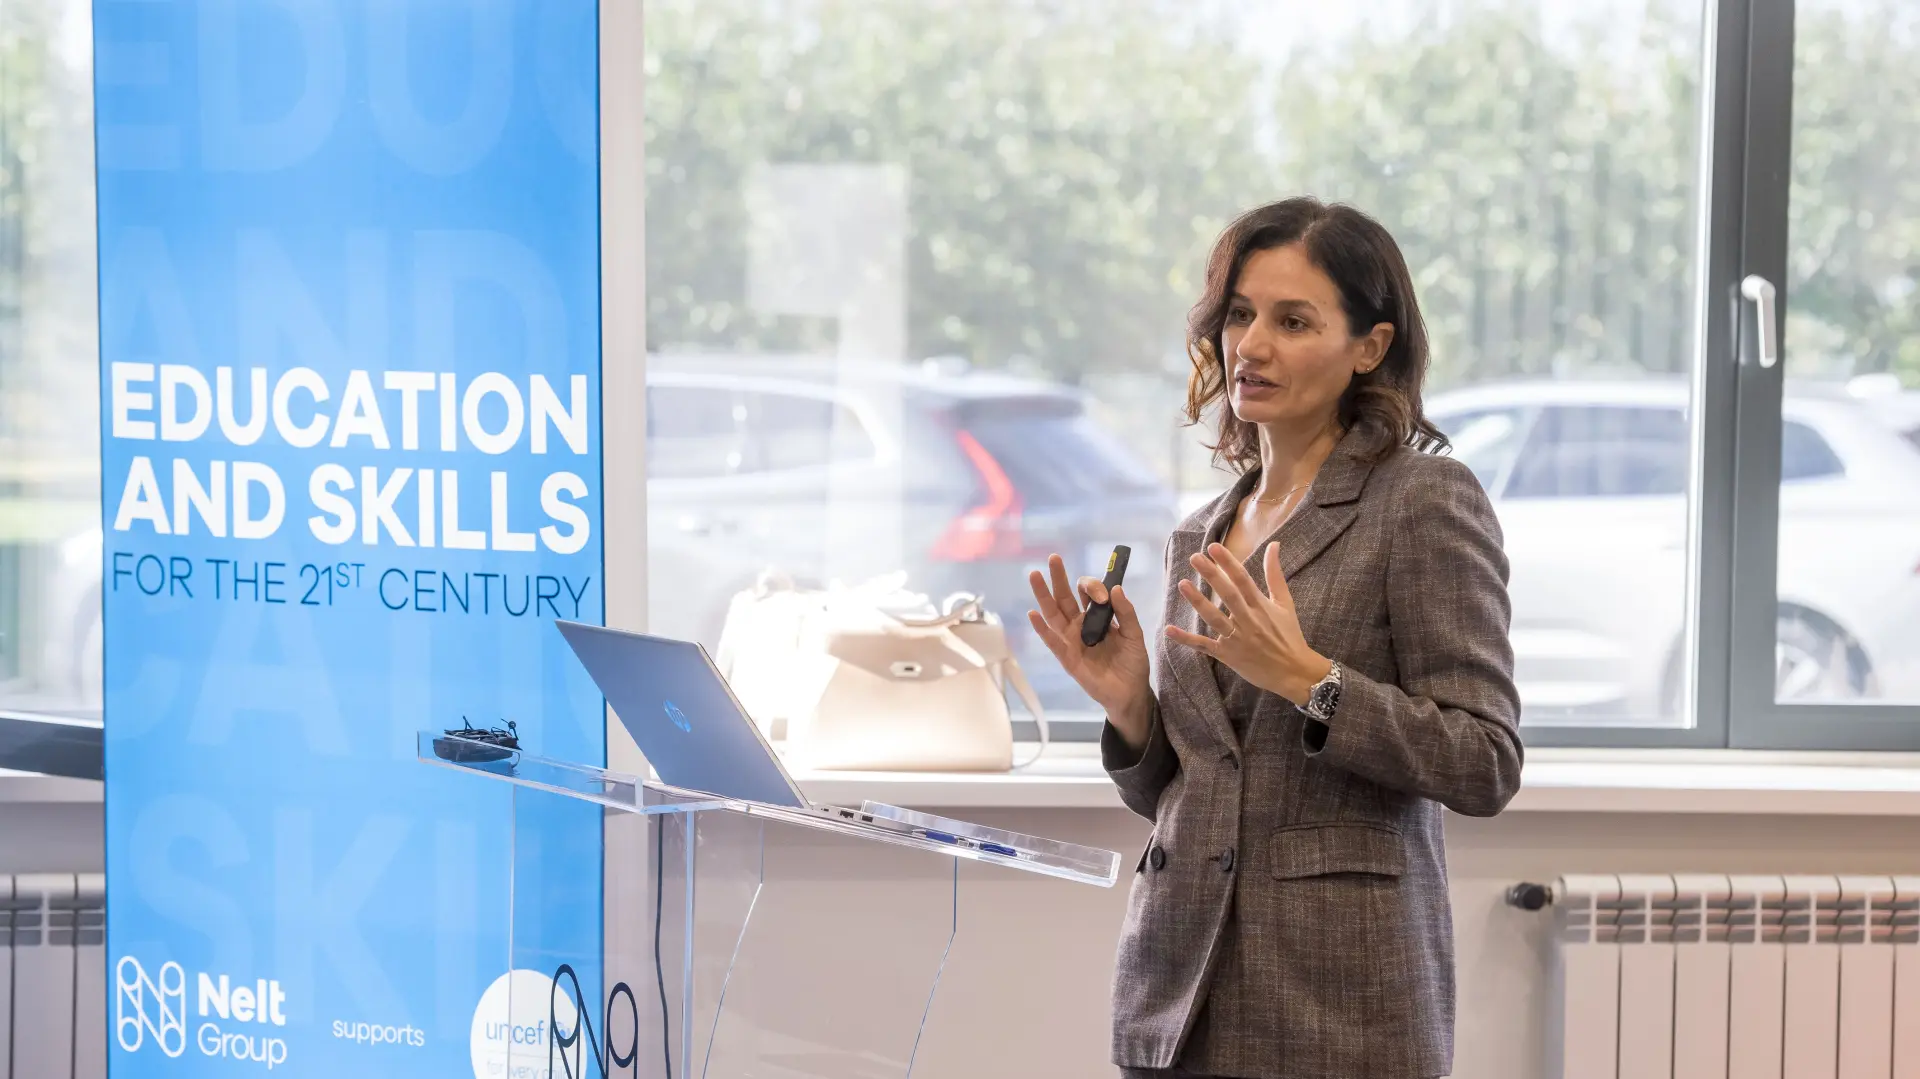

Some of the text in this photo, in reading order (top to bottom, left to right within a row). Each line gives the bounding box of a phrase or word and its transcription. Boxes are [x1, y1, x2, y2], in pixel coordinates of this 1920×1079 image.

[111, 361, 589, 455] EDUCATION
[113, 456, 590, 554] AND SKILLS
[113, 552, 591, 618] FOR THE 21ST CENTURY
[198, 972, 286, 1026] Nelt
[197, 1022, 287, 1070] Group
[332, 1019, 425, 1047] supports
[486, 1020, 544, 1045] uncef
